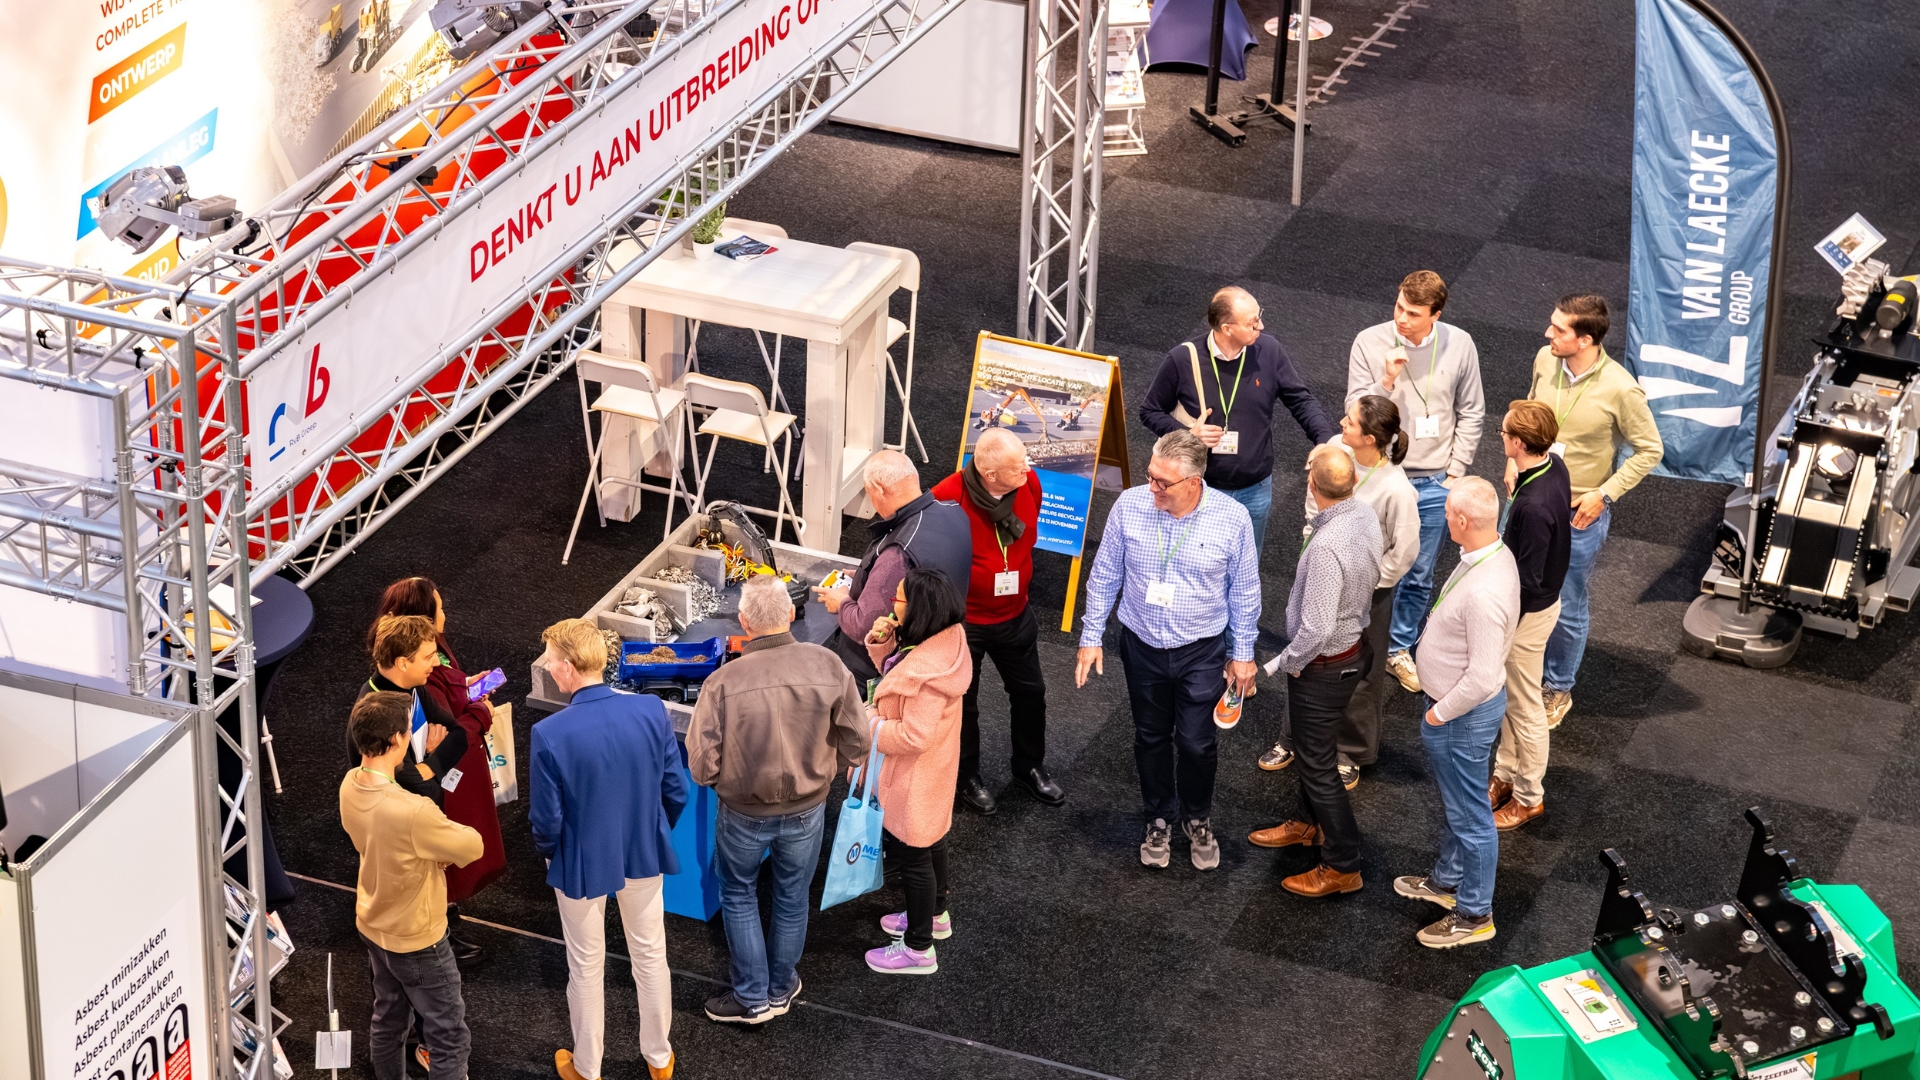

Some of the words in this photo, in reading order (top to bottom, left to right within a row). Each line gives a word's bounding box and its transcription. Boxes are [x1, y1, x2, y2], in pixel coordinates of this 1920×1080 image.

[96, 0, 164, 51] COMPLETE
[99, 42, 177, 104] ONTWERP
[470, 183, 558, 284] DENKT
[565, 165, 582, 206] U
[589, 119, 641, 192] AAN
[649, 4, 791, 141] UITBREIDING
[1686, 129, 1730, 254] LAECKE
[1681, 258, 1723, 320] VAN
[1728, 270, 1754, 326] GROUP
[1038, 377, 1065, 387] LOCATIE
[1068, 382, 1083, 390] VAN
[300, 422, 317, 440] Groep
[1050, 520, 1078, 530] NOVEMBER
[1057, 512, 1084, 522] RECYCLING
[75, 984, 109, 1025] Asbest
[111, 928, 166, 989] minizakken
[75, 1008, 109, 1051] Asbest
[111, 949, 170, 1014] kuubzakken
[73, 1036, 108, 1078] Asbest
[110, 970, 174, 1045] platenzakken
[104, 985, 182, 1072] containerzakken
